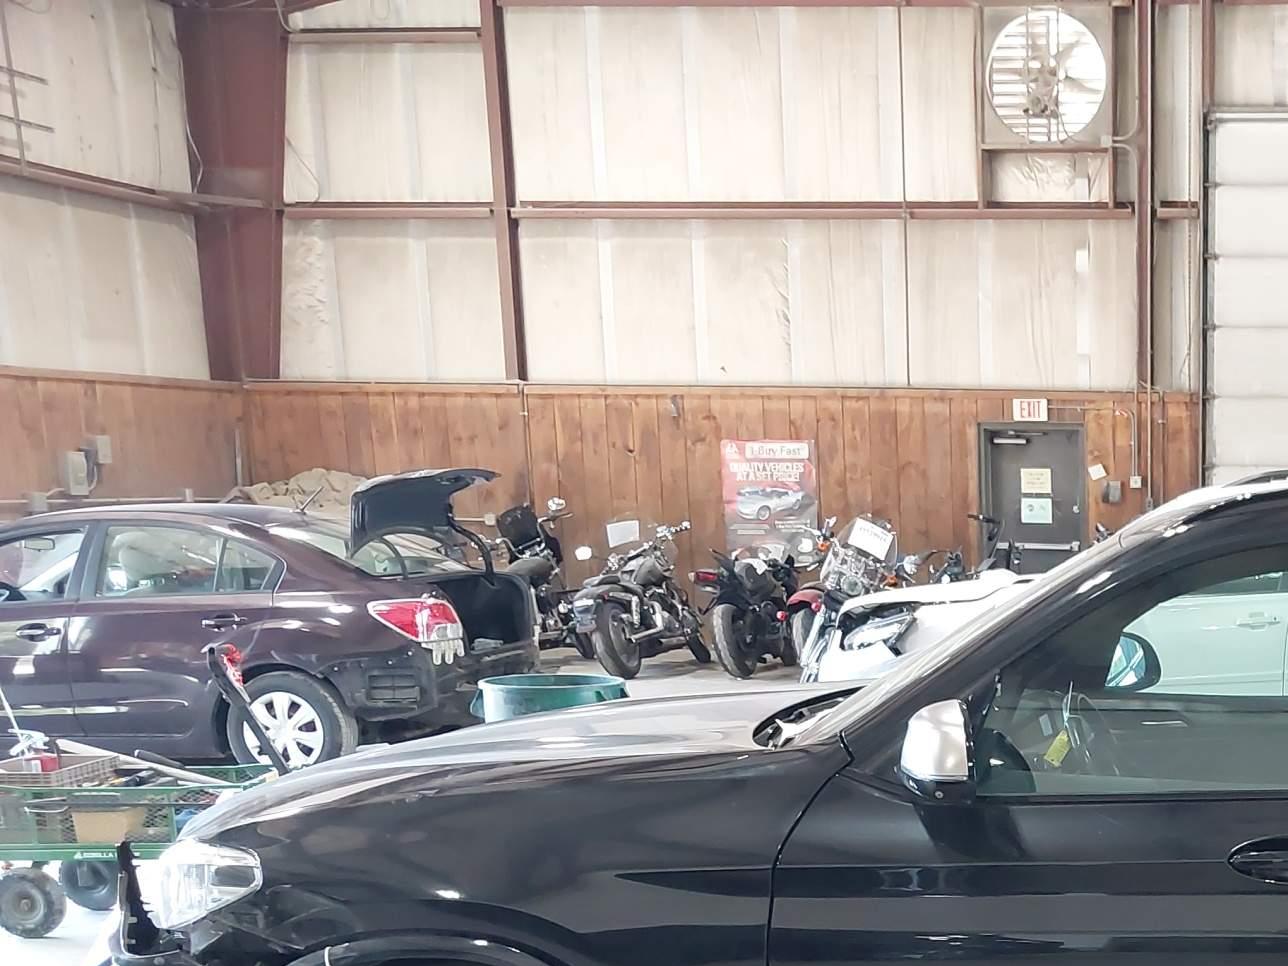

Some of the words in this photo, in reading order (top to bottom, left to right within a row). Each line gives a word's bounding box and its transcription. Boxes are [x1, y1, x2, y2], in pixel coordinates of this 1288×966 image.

[1019, 401, 1041, 419] EXIT
[729, 462, 763, 472] QUALITY
[764, 462, 805, 472] VEHICLES
